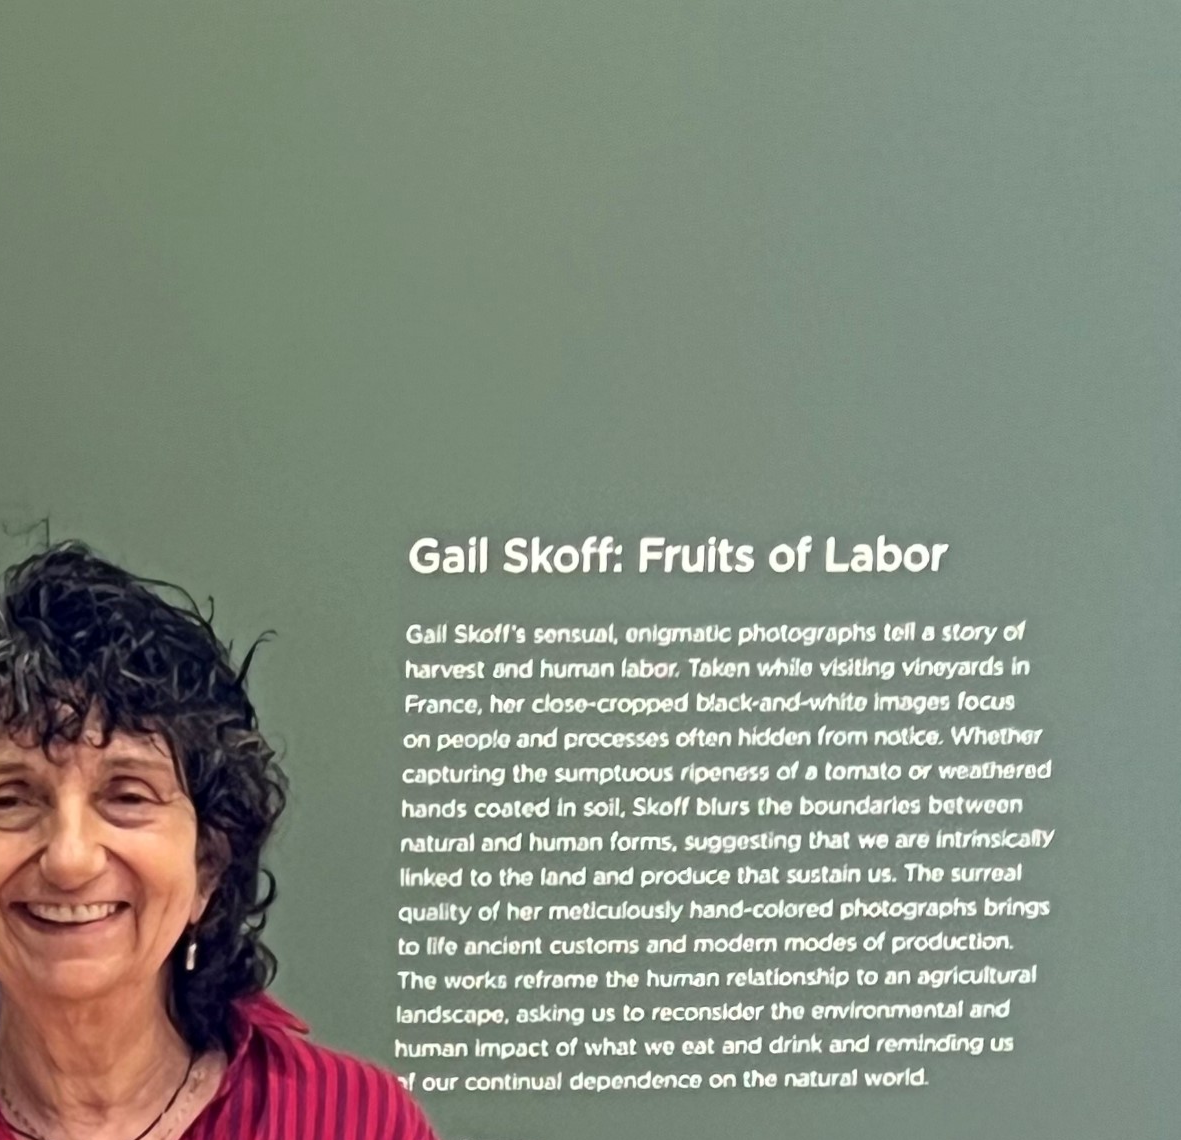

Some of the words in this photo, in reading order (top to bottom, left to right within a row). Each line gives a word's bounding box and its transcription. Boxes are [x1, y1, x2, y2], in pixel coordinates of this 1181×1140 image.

[408, 535, 489, 575] Gail
[502, 535, 623, 574] Skoff:
[638, 535, 755, 574] Fruits
[768, 534, 813, 573] of
[825, 534, 950, 573] Labor
[405, 623, 448, 645] Gail
[453, 622, 527, 644] Skoff's
[533, 622, 619, 646] sensual,
[625, 623, 732, 647] enigmatic
[737, 621, 877, 647] photographs
[883, 620, 917, 643] tell
[921, 625, 936, 642] a
[941, 622, 998, 646] story
[1002, 619, 1027, 642] of
[405, 659, 486, 680] harvest
[492, 658, 534, 679] and
[539, 658, 615, 679] human
[621, 657, 680, 679] labor.
[687, 656, 751, 679] Taken
[756, 656, 813, 678] while
[819, 656, 896, 681] visiting
[901, 655, 1005, 680] vineyards
[1010, 655, 1031, 676] in
[404, 693, 483, 716] France,
[489, 693, 526, 714] her
[531, 691, 690, 717] close-cropped
[695, 690, 868, 713] black-and-white
[873, 691, 951, 715] images
[957, 690, 1016, 712] focus
[402, 733, 431, 749] on
[436, 728, 512, 752] people
[515, 726, 559, 749] and
[563, 731, 670, 752] processes
[675, 726, 732, 748] often
[737, 725, 812, 747] hidden
[817, 724, 869, 747] from
[873, 725, 944, 747] notice.
[950, 725, 1044, 746] Whether
[401, 763, 506, 787] capturing
[512, 763, 548, 784] the
[554, 764, 674, 786] sumptuous
[680, 762, 770, 785] ripeness
[775, 759, 800, 781] of
[804, 764, 818, 781] a
[824, 761, 902, 782] tomato
[907, 763, 933, 781] or
[937, 758, 1053, 780] weathered
[401, 798, 468, 819] hands
[473, 796, 551, 819] coated
[556, 796, 577, 818] in
[583, 796, 626, 819] soil,
[631, 795, 691, 817] Skoff
[696, 796, 751, 817] blurs
[757, 795, 793, 816] the
[799, 794, 922, 816] boundaries
[928, 794, 1024, 815] between
[400, 832, 476, 853] natural
[480, 832, 523, 853] and
[528, 831, 604, 852] human
[609, 830, 678, 853] forms,
[683, 830, 802, 855] suggesting
[808, 829, 851, 850] that
[857, 833, 890, 850] we
[894, 832, 931, 849] are
[935, 828, 1056, 849] intrinsically
[399, 866, 464, 888] linked
[469, 868, 493, 888] to
[498, 866, 534, 888] the
[540, 865, 587, 887] land
[592, 866, 635, 886] and
[640, 866, 731, 889] produce
[737, 865, 780, 885] that
[785, 863, 862, 885] sustain
[867, 867, 898, 884] us.
[903, 862, 945, 883] The
[950, 862, 1023, 883] surreal
[397, 902, 473, 926] quality
[477, 899, 501, 922] of
[506, 901, 544, 922] her
[548, 899, 684, 923] meticulously
[689, 898, 834, 919] hand-colored
[839, 896, 978, 921] photographs
[983, 896, 1051, 920] brings
[397, 937, 421, 956] to
[426, 935, 458, 957] life
[463, 935, 543, 956] ancient
[549, 936, 640, 955] customs
[645, 933, 688, 954] and
[693, 932, 778, 953] modern
[783, 931, 858, 953] modes
[862, 930, 887, 952] of
[891, 930, 1014, 955] production.
[396, 970, 438, 991] The
[443, 970, 508, 990] works
[514, 969, 599, 990] reframe
[605, 969, 640, 989] the
[646, 968, 720, 988] human
[726, 965, 850, 989] relationship
[856, 968, 879, 986] to
[883, 969, 912, 986] an
[916, 964, 1038, 989] agricultural
[396, 1004, 510, 1027] landscape,
[515, 1003, 585, 1027] asking
[591, 1007, 616, 1023] us
[622, 1004, 645, 1022] to
[651, 1001, 765, 1022] reconsider
[770, 1001, 806, 1021] the
[811, 999, 964, 1021] environmental
[969, 998, 1011, 1019] and
[394, 1038, 469, 1058] human
[474, 1038, 549, 1061] impact
[555, 1036, 579, 1057] of
[584, 1036, 638, 1057] what
[643, 1039, 676, 1056] we
[681, 1037, 716, 1056] eat
[721, 1036, 763, 1055] and
[768, 1032, 823, 1055] drink
[828, 1033, 871, 1054] and
[875, 1032, 985, 1056] reminding
[990, 1036, 1014, 1052] us
[421, 1076, 460, 1092] our
[464, 1071, 563, 1091] continual
[569, 1069, 703, 1093] dependence
[708, 1073, 737, 1089] on
[742, 1069, 778, 1088] the
[783, 1068, 858, 1088] natural
[864, 1066, 930, 1087] world.
